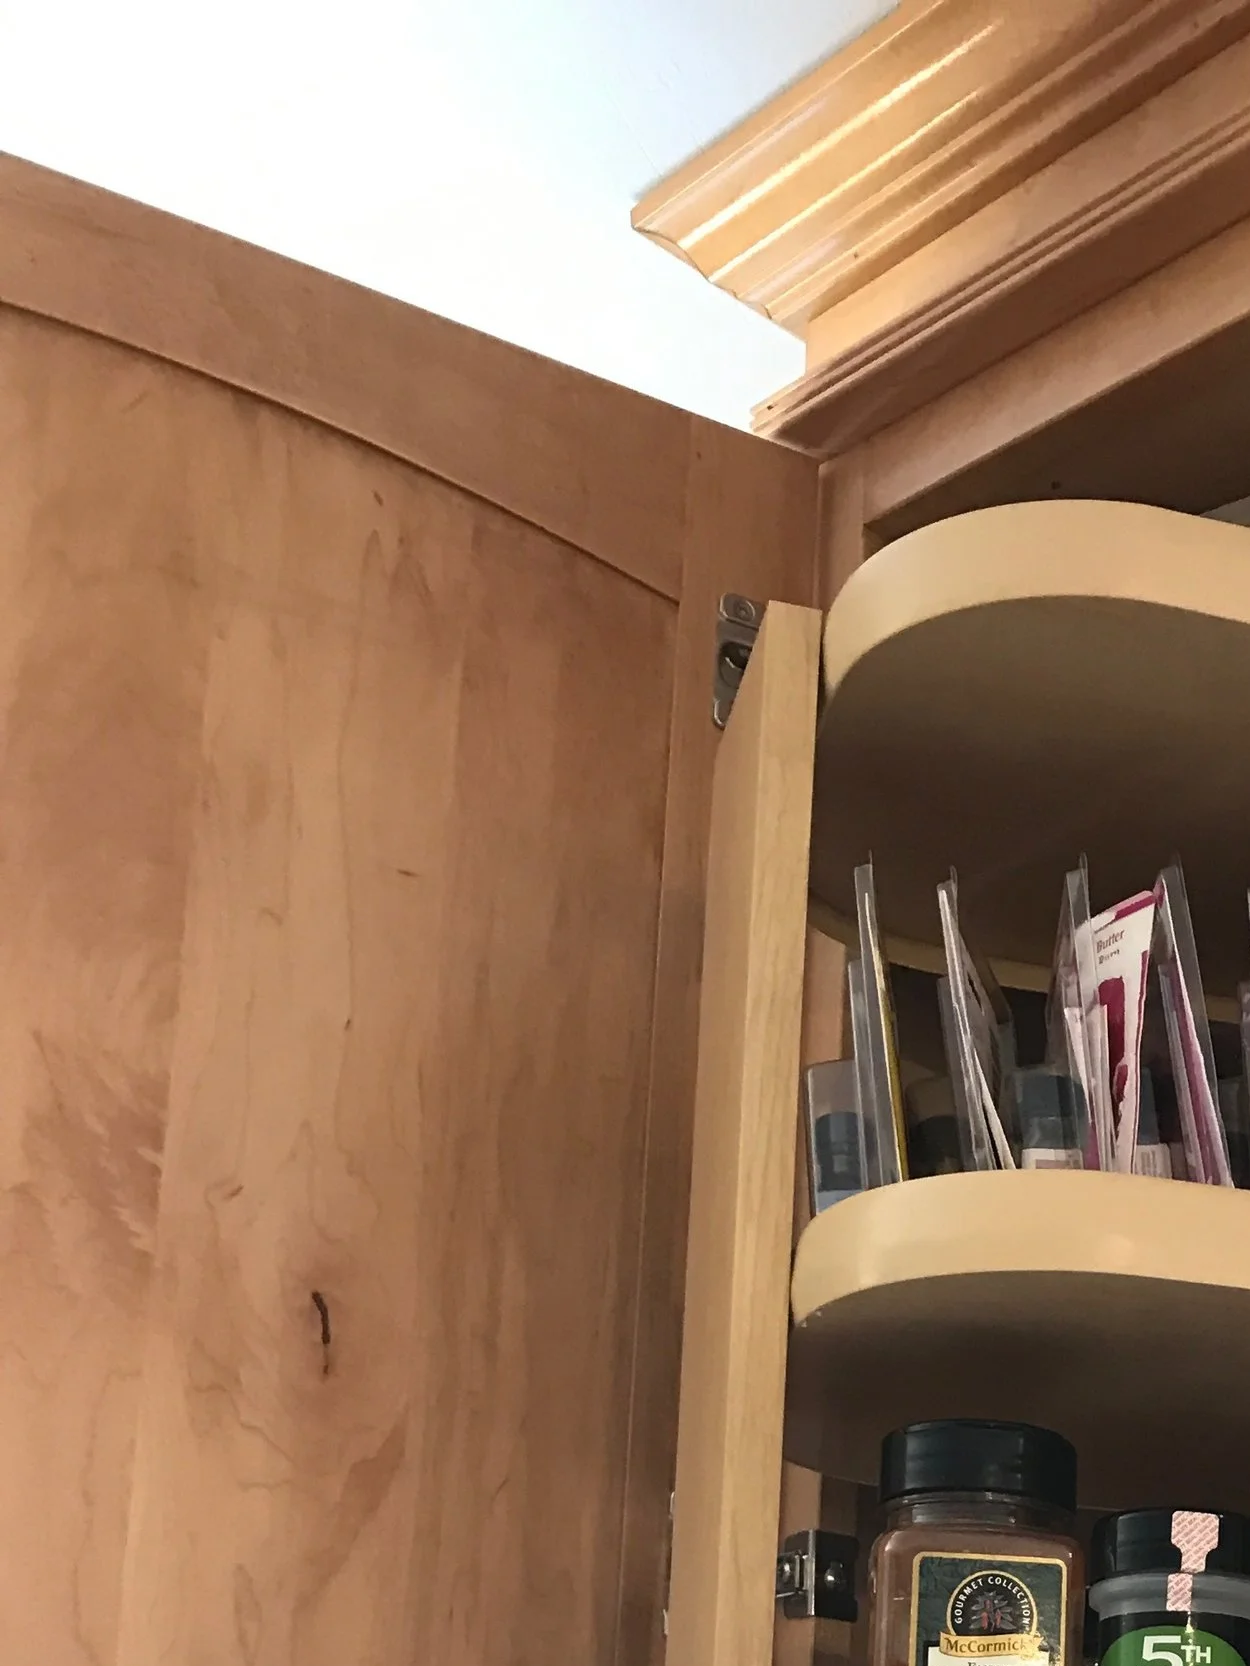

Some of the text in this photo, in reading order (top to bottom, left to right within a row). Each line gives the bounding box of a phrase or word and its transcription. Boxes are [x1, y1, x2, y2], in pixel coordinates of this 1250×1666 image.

[954, 1575, 1031, 1625] GOURMET COLLECTION
[944, 1637, 1026, 1653] McCormick
